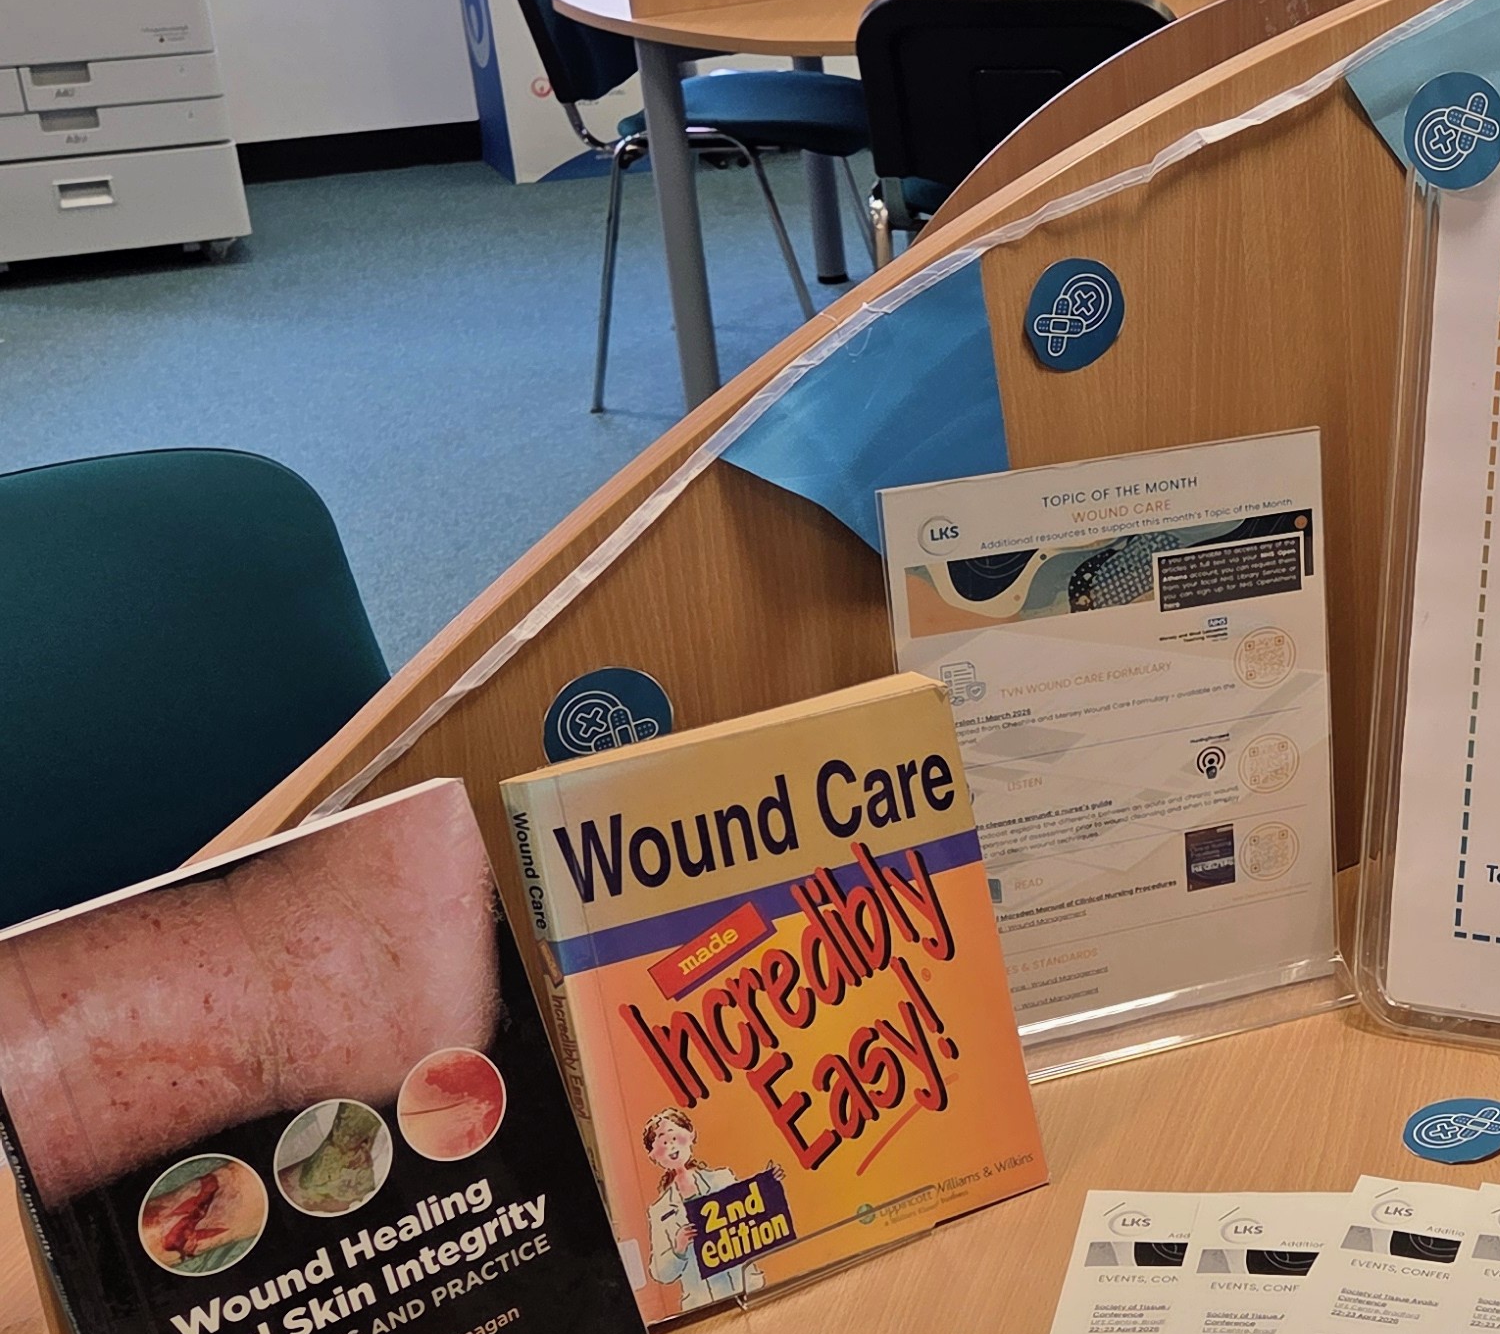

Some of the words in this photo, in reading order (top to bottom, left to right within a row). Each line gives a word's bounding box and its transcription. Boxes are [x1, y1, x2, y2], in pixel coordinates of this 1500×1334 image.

[1042, 491, 1087, 508] TOPIC
[1091, 487, 1110, 503] OF
[1115, 483, 1141, 498] THE
[1146, 477, 1198, 494] MONTH
[1071, 504, 1129, 524] WOUND
[1133, 499, 1172, 516] CARE
[930, 524, 960, 543] LKS
[980, 534, 1033, 550] Additional
[1036, 530, 1084, 543] resources
[1087, 526, 1099, 535] to
[1101, 519, 1139, 535] support
[1142, 517, 1160, 528] this
[1163, 510, 1202, 525] month's
[1205, 506, 1231, 521] Topic
[1233, 504, 1243, 514] of
[1245, 501, 1262, 512] the
[1264, 497, 1293, 510] Month
[1000, 686, 1024, 698] TVN
[1026, 679, 1071, 696] WOUND
[1074, 673, 1104, 686] CARE
[1107, 662, 1172, 682] FORMULARY
[1007, 777, 1043, 792] LISTEN
[553, 773, 800, 904] Wound
[816, 752, 956, 838] Care
[511, 811, 536, 880] Wound
[526, 884, 548, 931] Care
[1014, 877, 1043, 891] READ
[1000, 907, 1034, 922] Marsden
[1035, 901, 1065, 914] Manual
[1075, 894, 1103, 907] Clinical
[1105, 889, 1134, 902] Nursing
[1135, 879, 1177, 894] Procedures
[677, 926, 739, 976] made
[1021, 963, 1030, 971] &
[1032, 948, 1098, 970] STANDARDS
[618, 841, 956, 1109] Incredibly
[746, 956, 960, 1171] Easy!
[983, 1166, 993, 1177] &
[994, 1152, 1034, 1173] Wilkins
[340, 1178, 493, 1268] Healing
[700, 1183, 766, 1233] 2nd
[1121, 1218, 1152, 1228] LKS
[1383, 1205, 1414, 1218] LKS
[382, 1194, 547, 1295] Integrity
[700, 1211, 791, 1269] edition
[1233, 1225, 1263, 1235] LKS
[432, 1234, 552, 1307] PRACTICE
